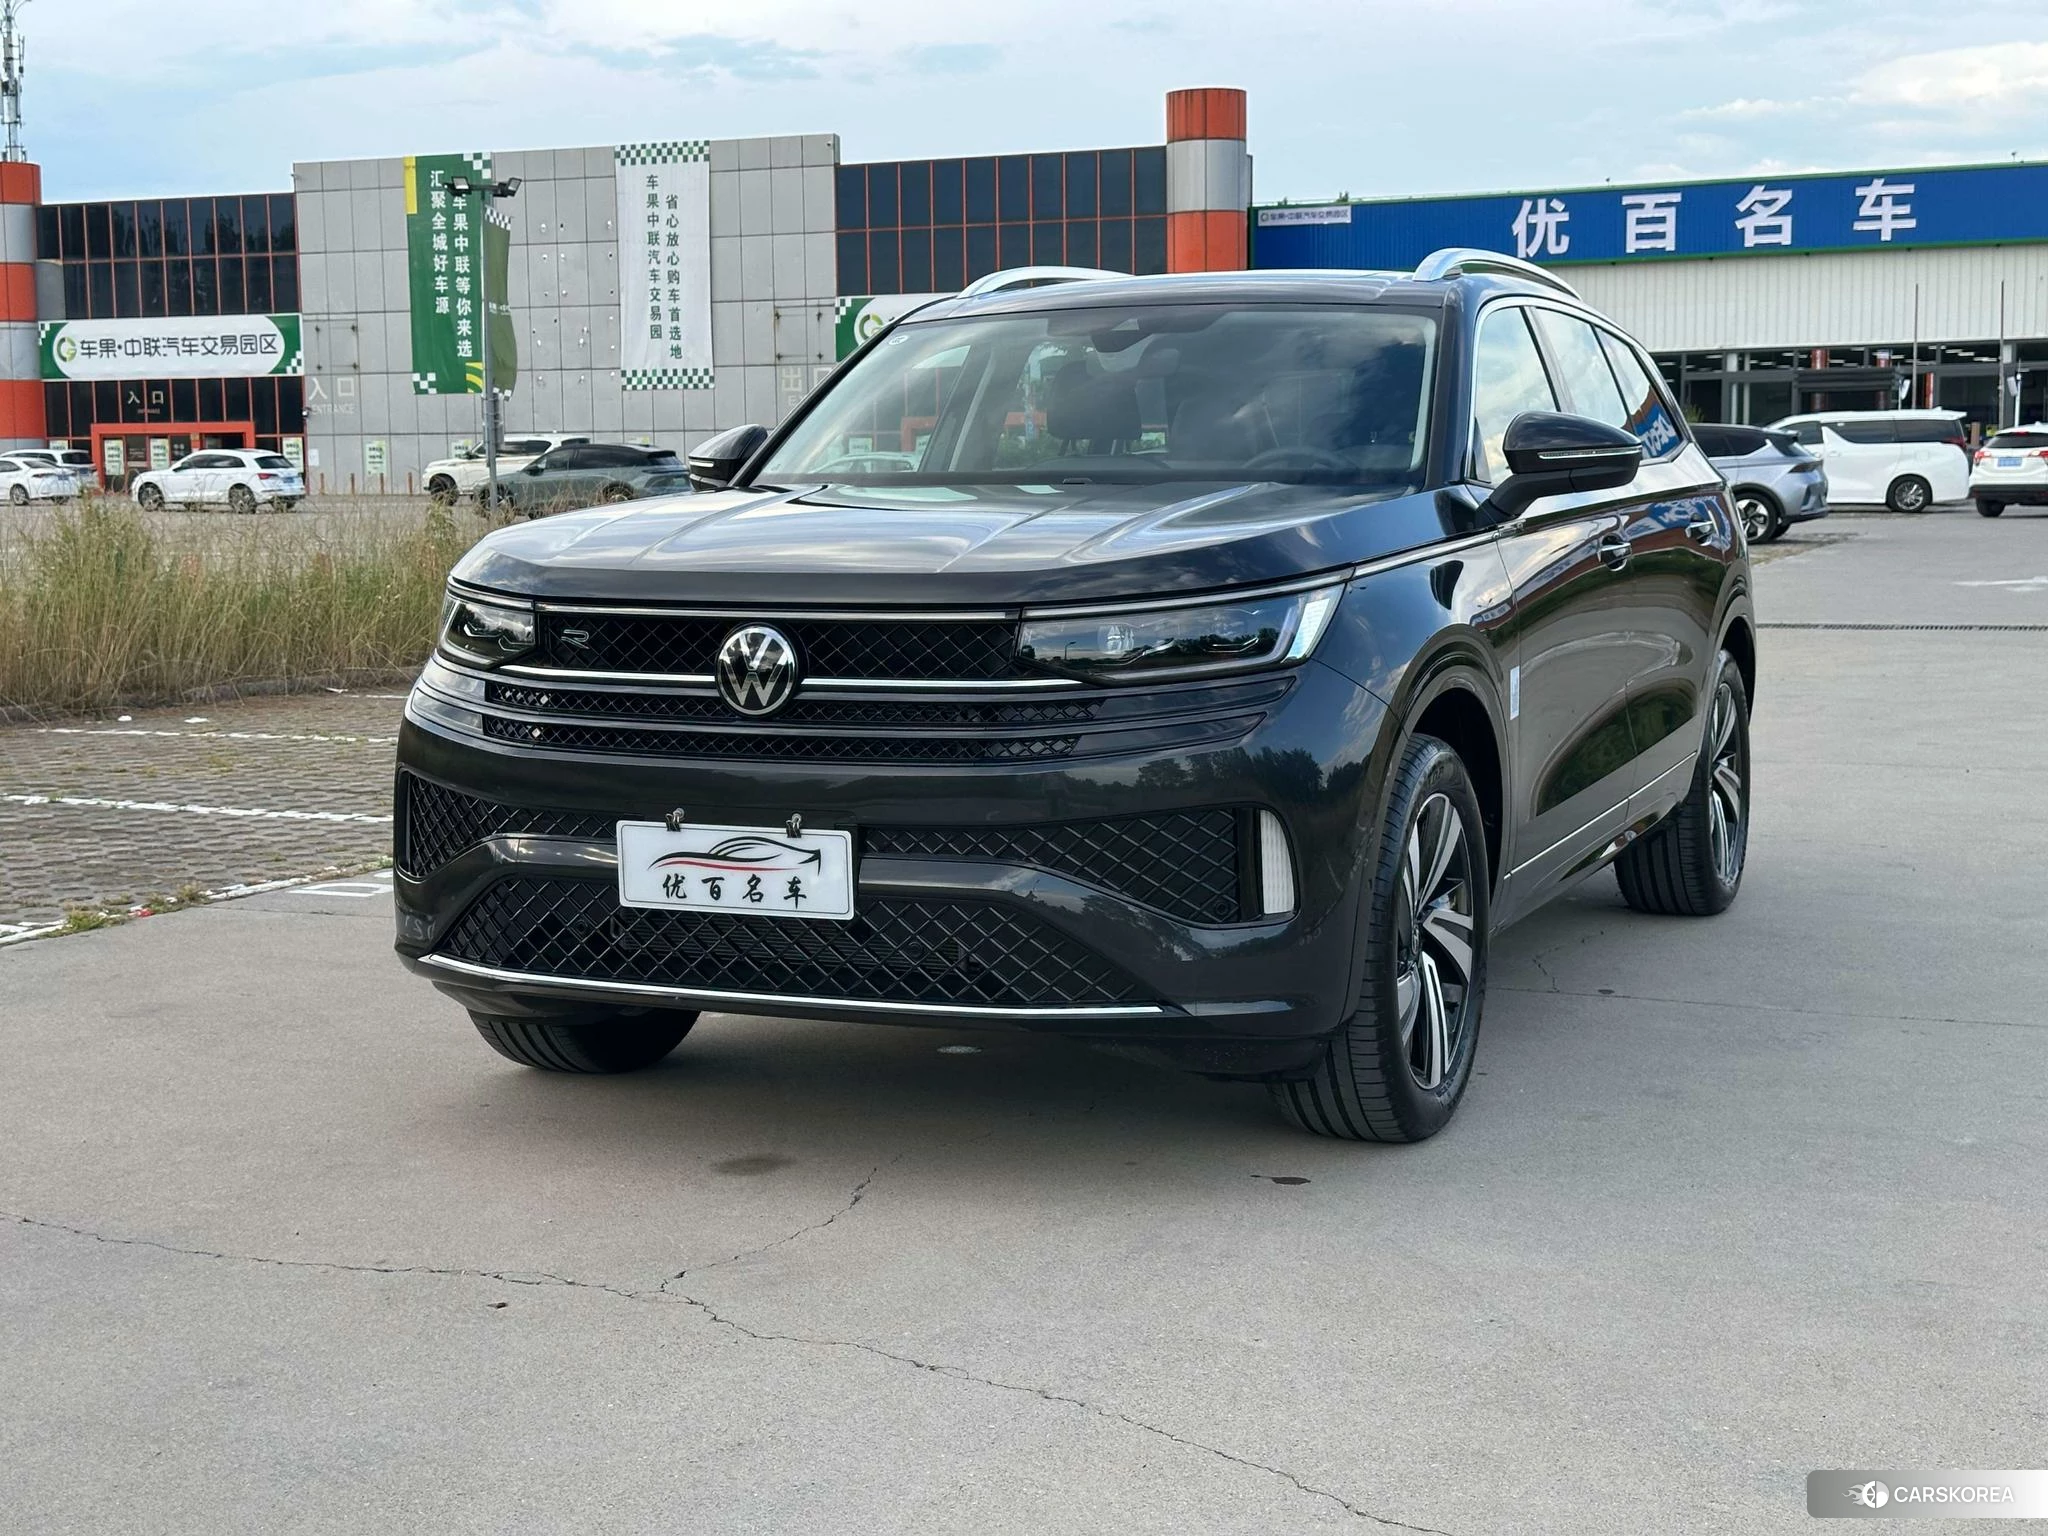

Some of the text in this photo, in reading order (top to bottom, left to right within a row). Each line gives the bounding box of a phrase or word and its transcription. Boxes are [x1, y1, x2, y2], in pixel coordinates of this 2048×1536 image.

[430, 170, 449, 314] 汇聚全城好车源
[645, 174, 663, 339] 车果中联汽车交易园
[1511, 178, 1917, 258] 优百名车
[453, 193, 472, 357] 车果中联等你来选
[665, 194, 683, 359] 省心放心购车首选地
[80, 333, 279, 359] 车果·中联汽车交易园区
[127, 390, 164, 404] 入口
[309, 377, 355, 400] 入口
[661, 873, 808, 909] 优百名车
